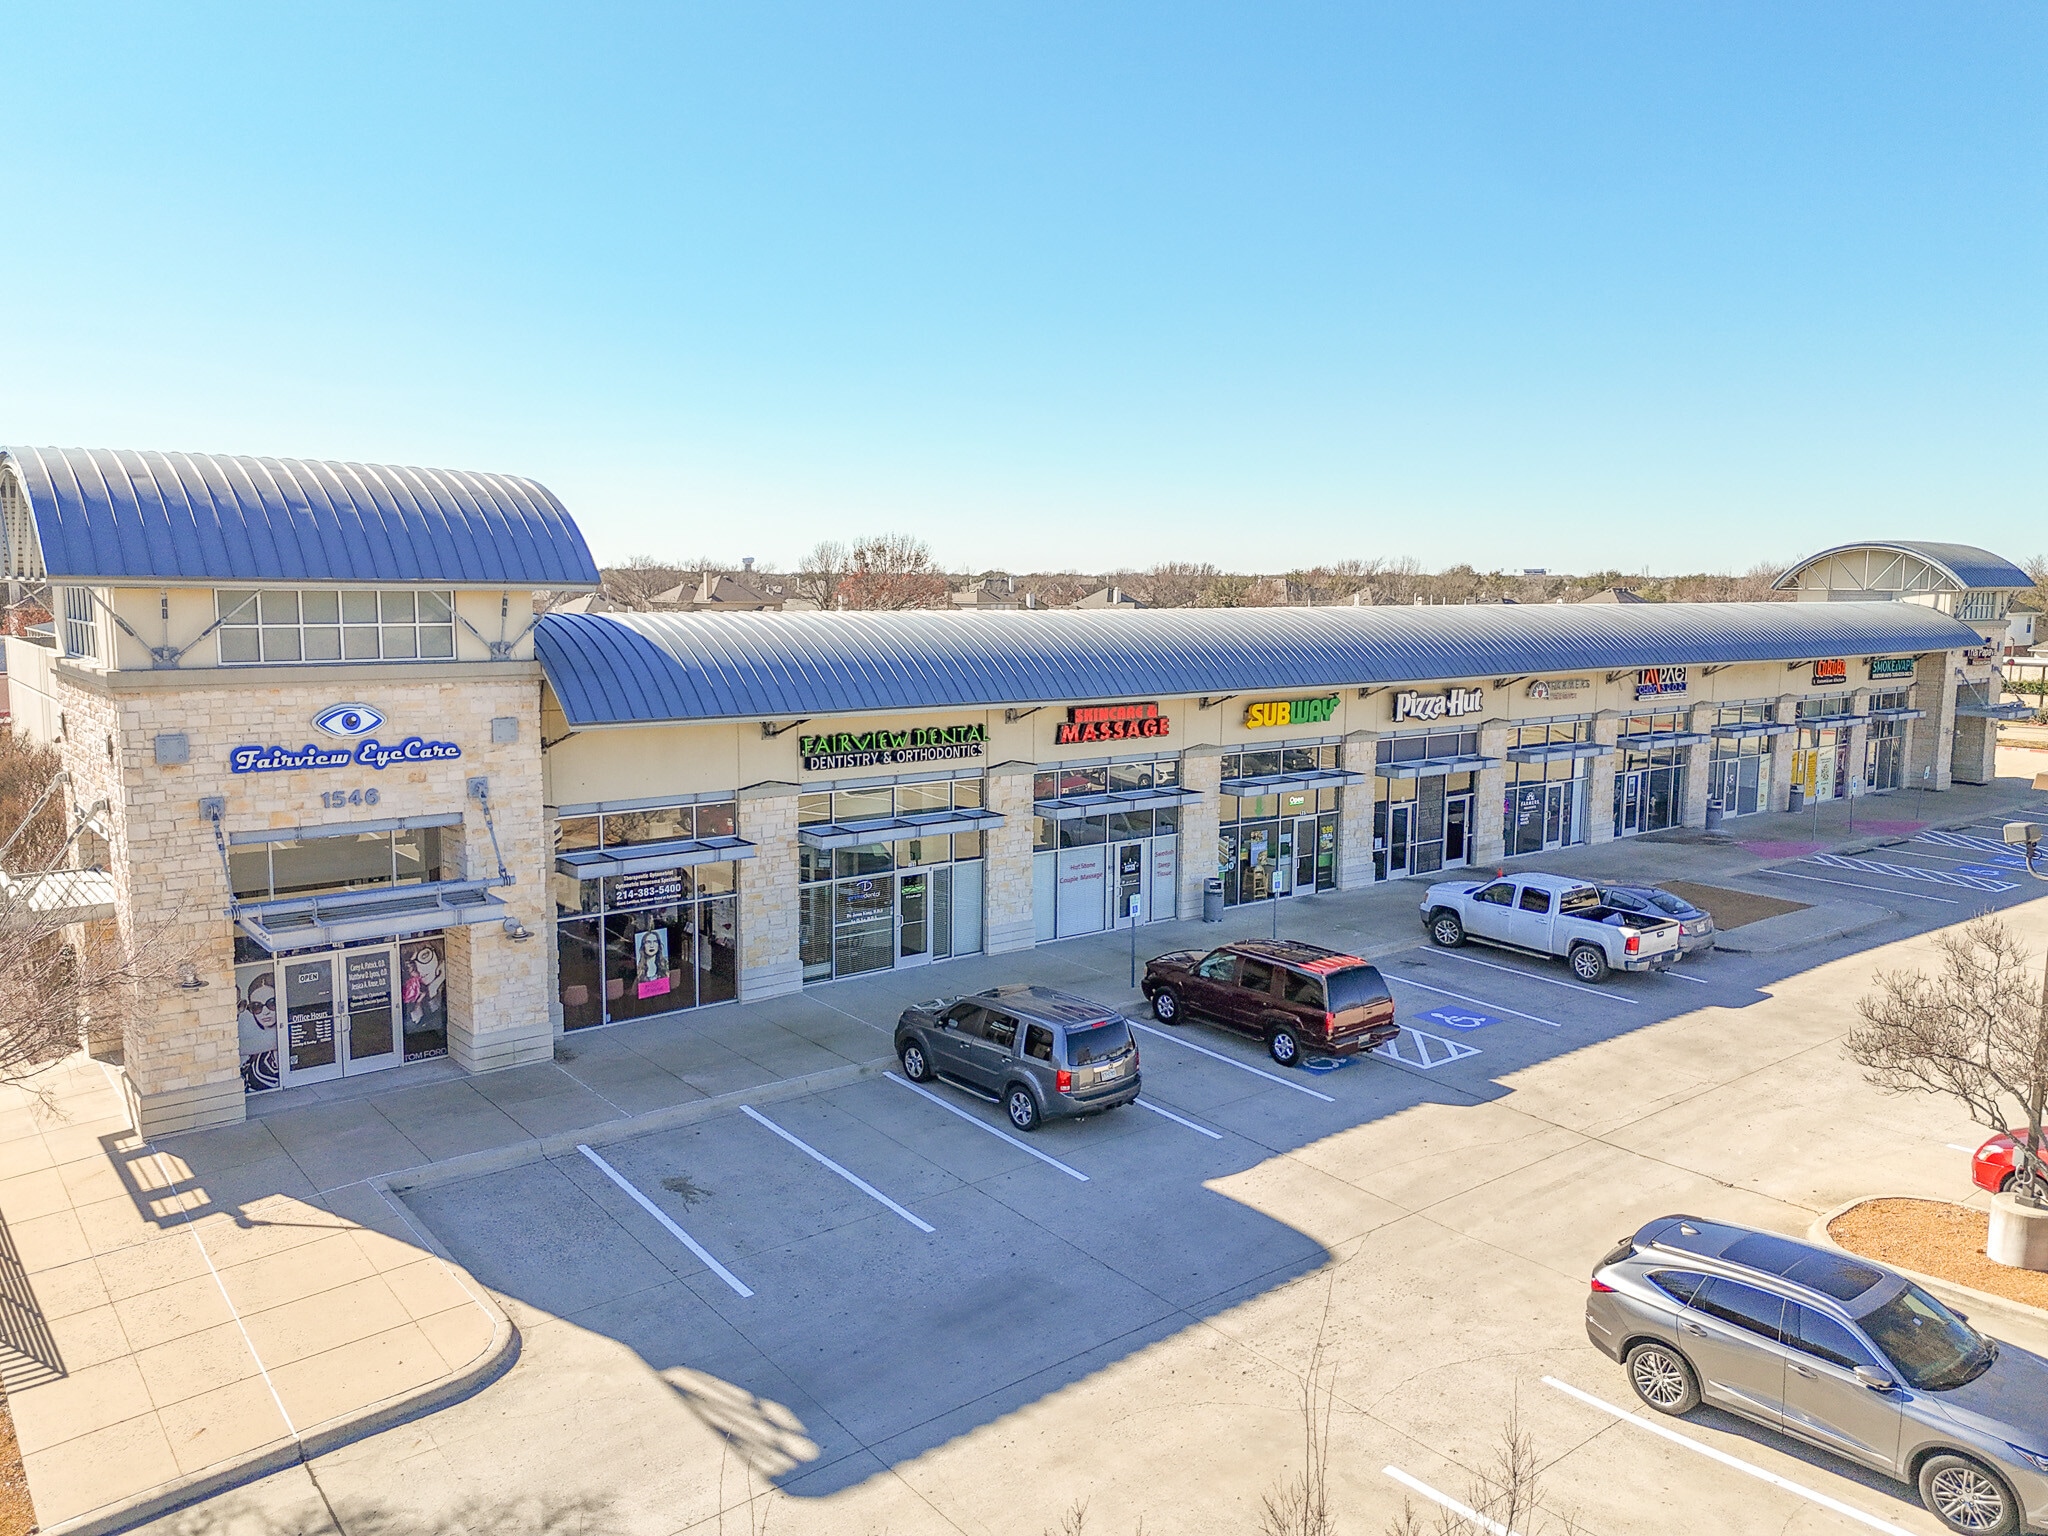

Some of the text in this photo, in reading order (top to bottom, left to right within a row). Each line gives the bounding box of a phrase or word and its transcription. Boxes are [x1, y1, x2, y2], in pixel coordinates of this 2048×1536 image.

[1873, 660, 1895, 673] SMOKE
[1246, 695, 1341, 729] SUBWAY
[1394, 689, 1483, 722] Pizza Hut
[803, 725, 991, 757] FAIRVIEW DENTAL
[1060, 718, 1169, 743] MASSAGE
[235, 741, 460, 771] Fairview EyeCare
[810, 744, 984, 770] DENTISTRY & ORTHODONTICS
[321, 788, 380, 809] 1546
[616, 883, 681, 900] 214-383-5400
[300, 974, 318, 982] OPEN
[292, 1012, 328, 1022] Office Hours
[405, 1048, 447, 1062] TOM FORD
